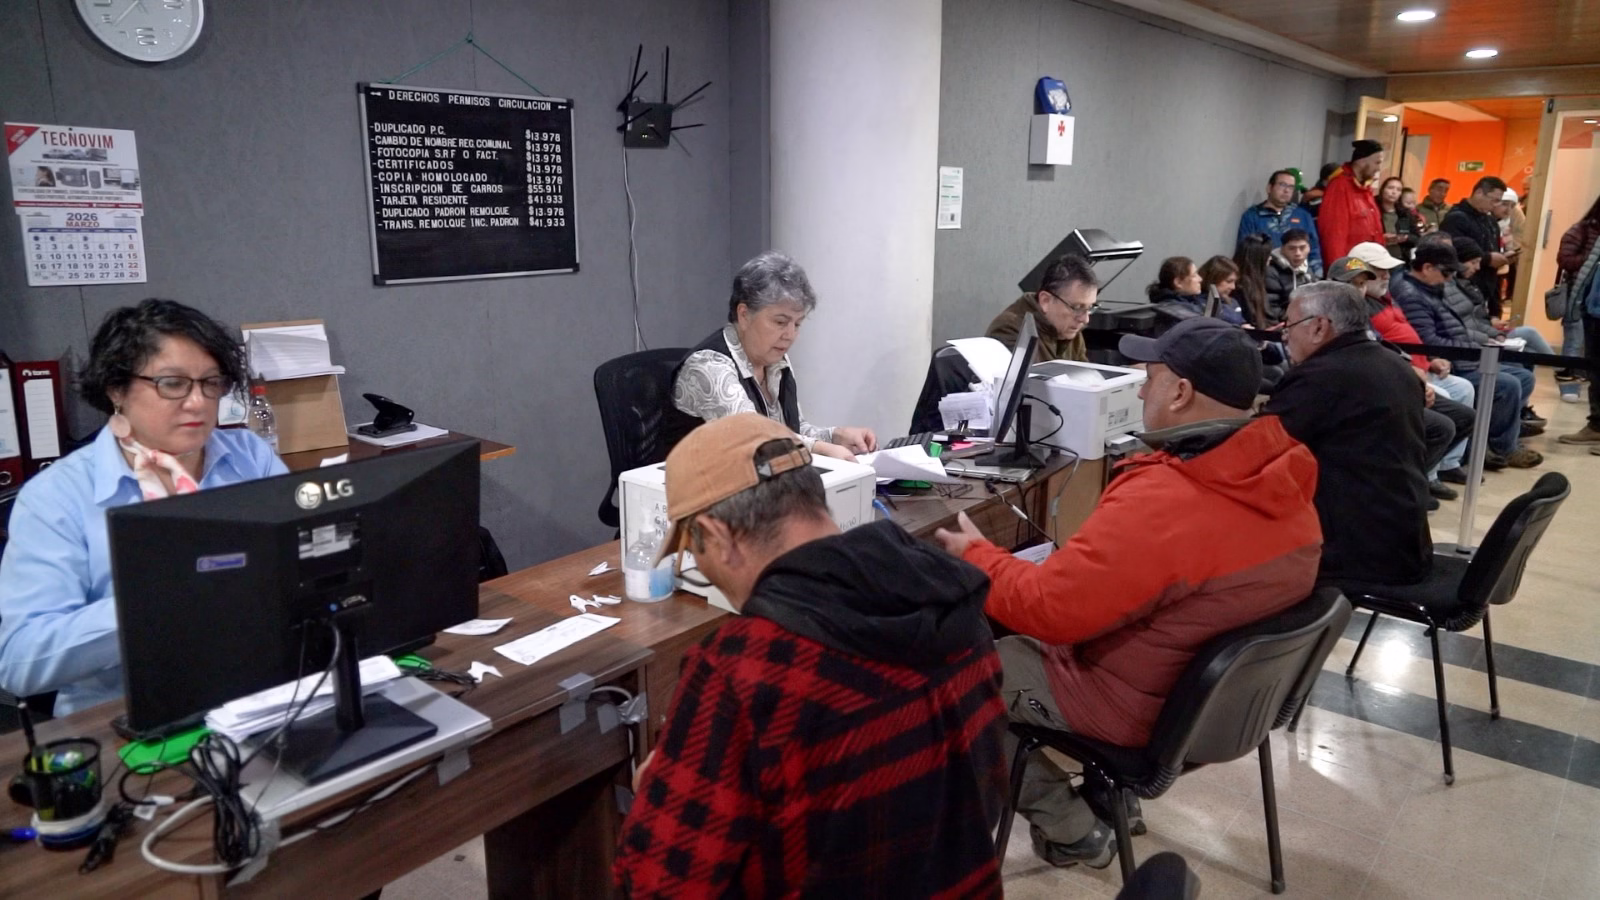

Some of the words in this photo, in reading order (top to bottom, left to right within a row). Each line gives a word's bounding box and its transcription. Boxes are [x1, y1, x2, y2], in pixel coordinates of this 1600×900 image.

[388, 90, 440, 103] DERECHOS
[448, 94, 491, 106] PERMISOS
[498, 98, 551, 111] CIRCULACION
[41, 131, 114, 149] TECNOVIM
[410, 136, 423, 147] DE
[424, 136, 457, 148] NOMBRE
[475, 138, 512, 150] COMUNAL
[525, 141, 562, 153] $13.978
[526, 151, 562, 163] $13.978
[526, 162, 563, 174] $13.978
[421, 172, 488, 183] HOMOLOGADO
[452, 184, 463, 193] DE
[470, 184, 504, 194] CARROS
[527, 184, 562, 194] $55.911
[422, 195, 469, 205] RESIDENTE
[528, 194, 563, 205] $41.933
[66, 212, 98, 222] 2026
[434, 207, 466, 217] PADRON
[469, 206, 510, 216] REMOLQUE
[528, 205, 564, 217] $13.978
[419, 218, 466, 229] REMOLQUE
[490, 217, 519, 227] PADRON
[529, 216, 566, 228] $41.933
[323, 479, 354, 501] LG
